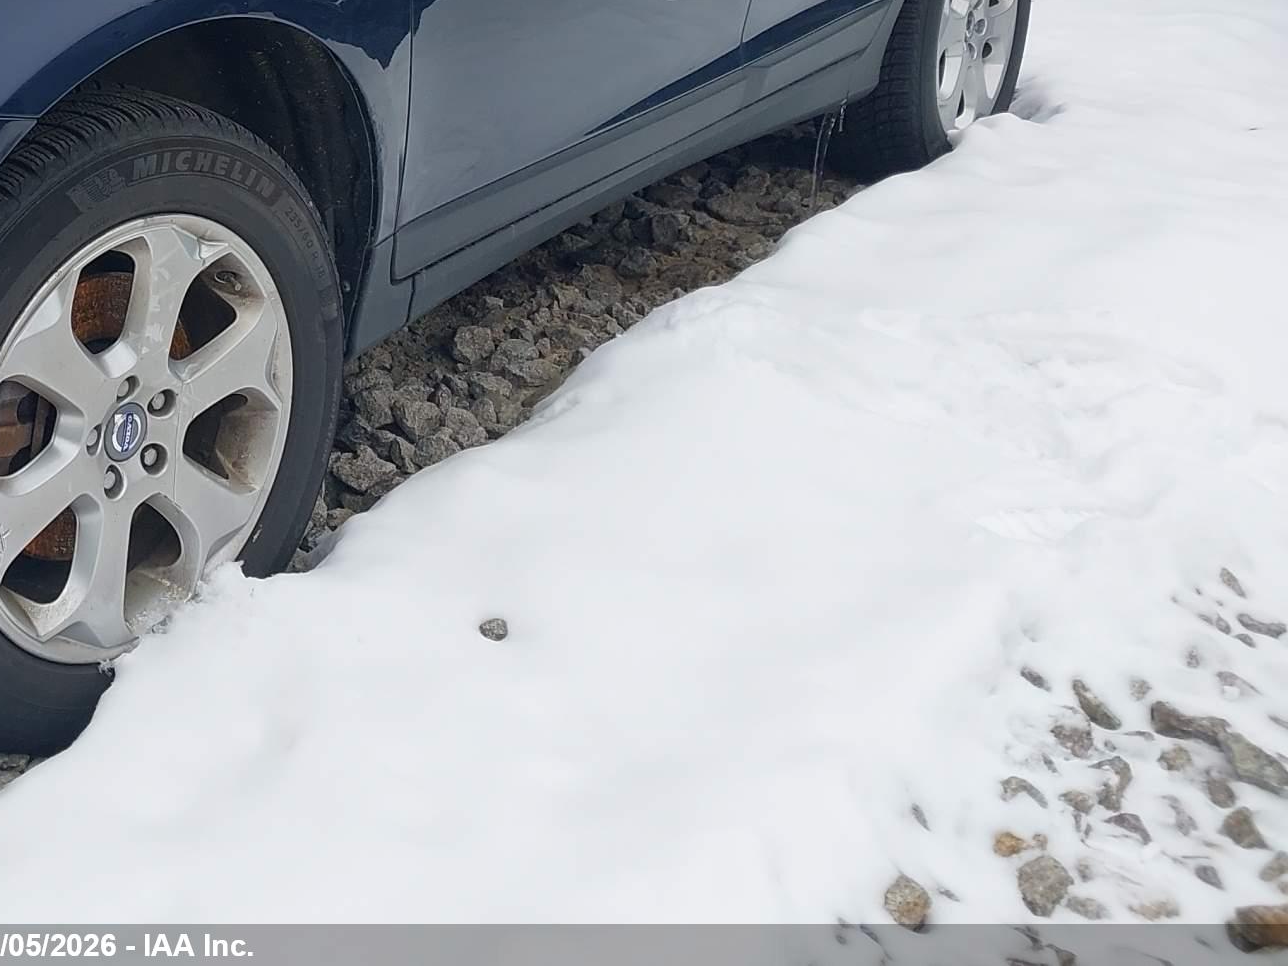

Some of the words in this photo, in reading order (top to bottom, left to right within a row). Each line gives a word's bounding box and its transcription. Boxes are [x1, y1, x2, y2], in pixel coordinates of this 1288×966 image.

[133, 150, 275, 199] MICHELIN
[285, 206, 314, 248] 235/60
[122, 414, 133, 451] VOLVO
